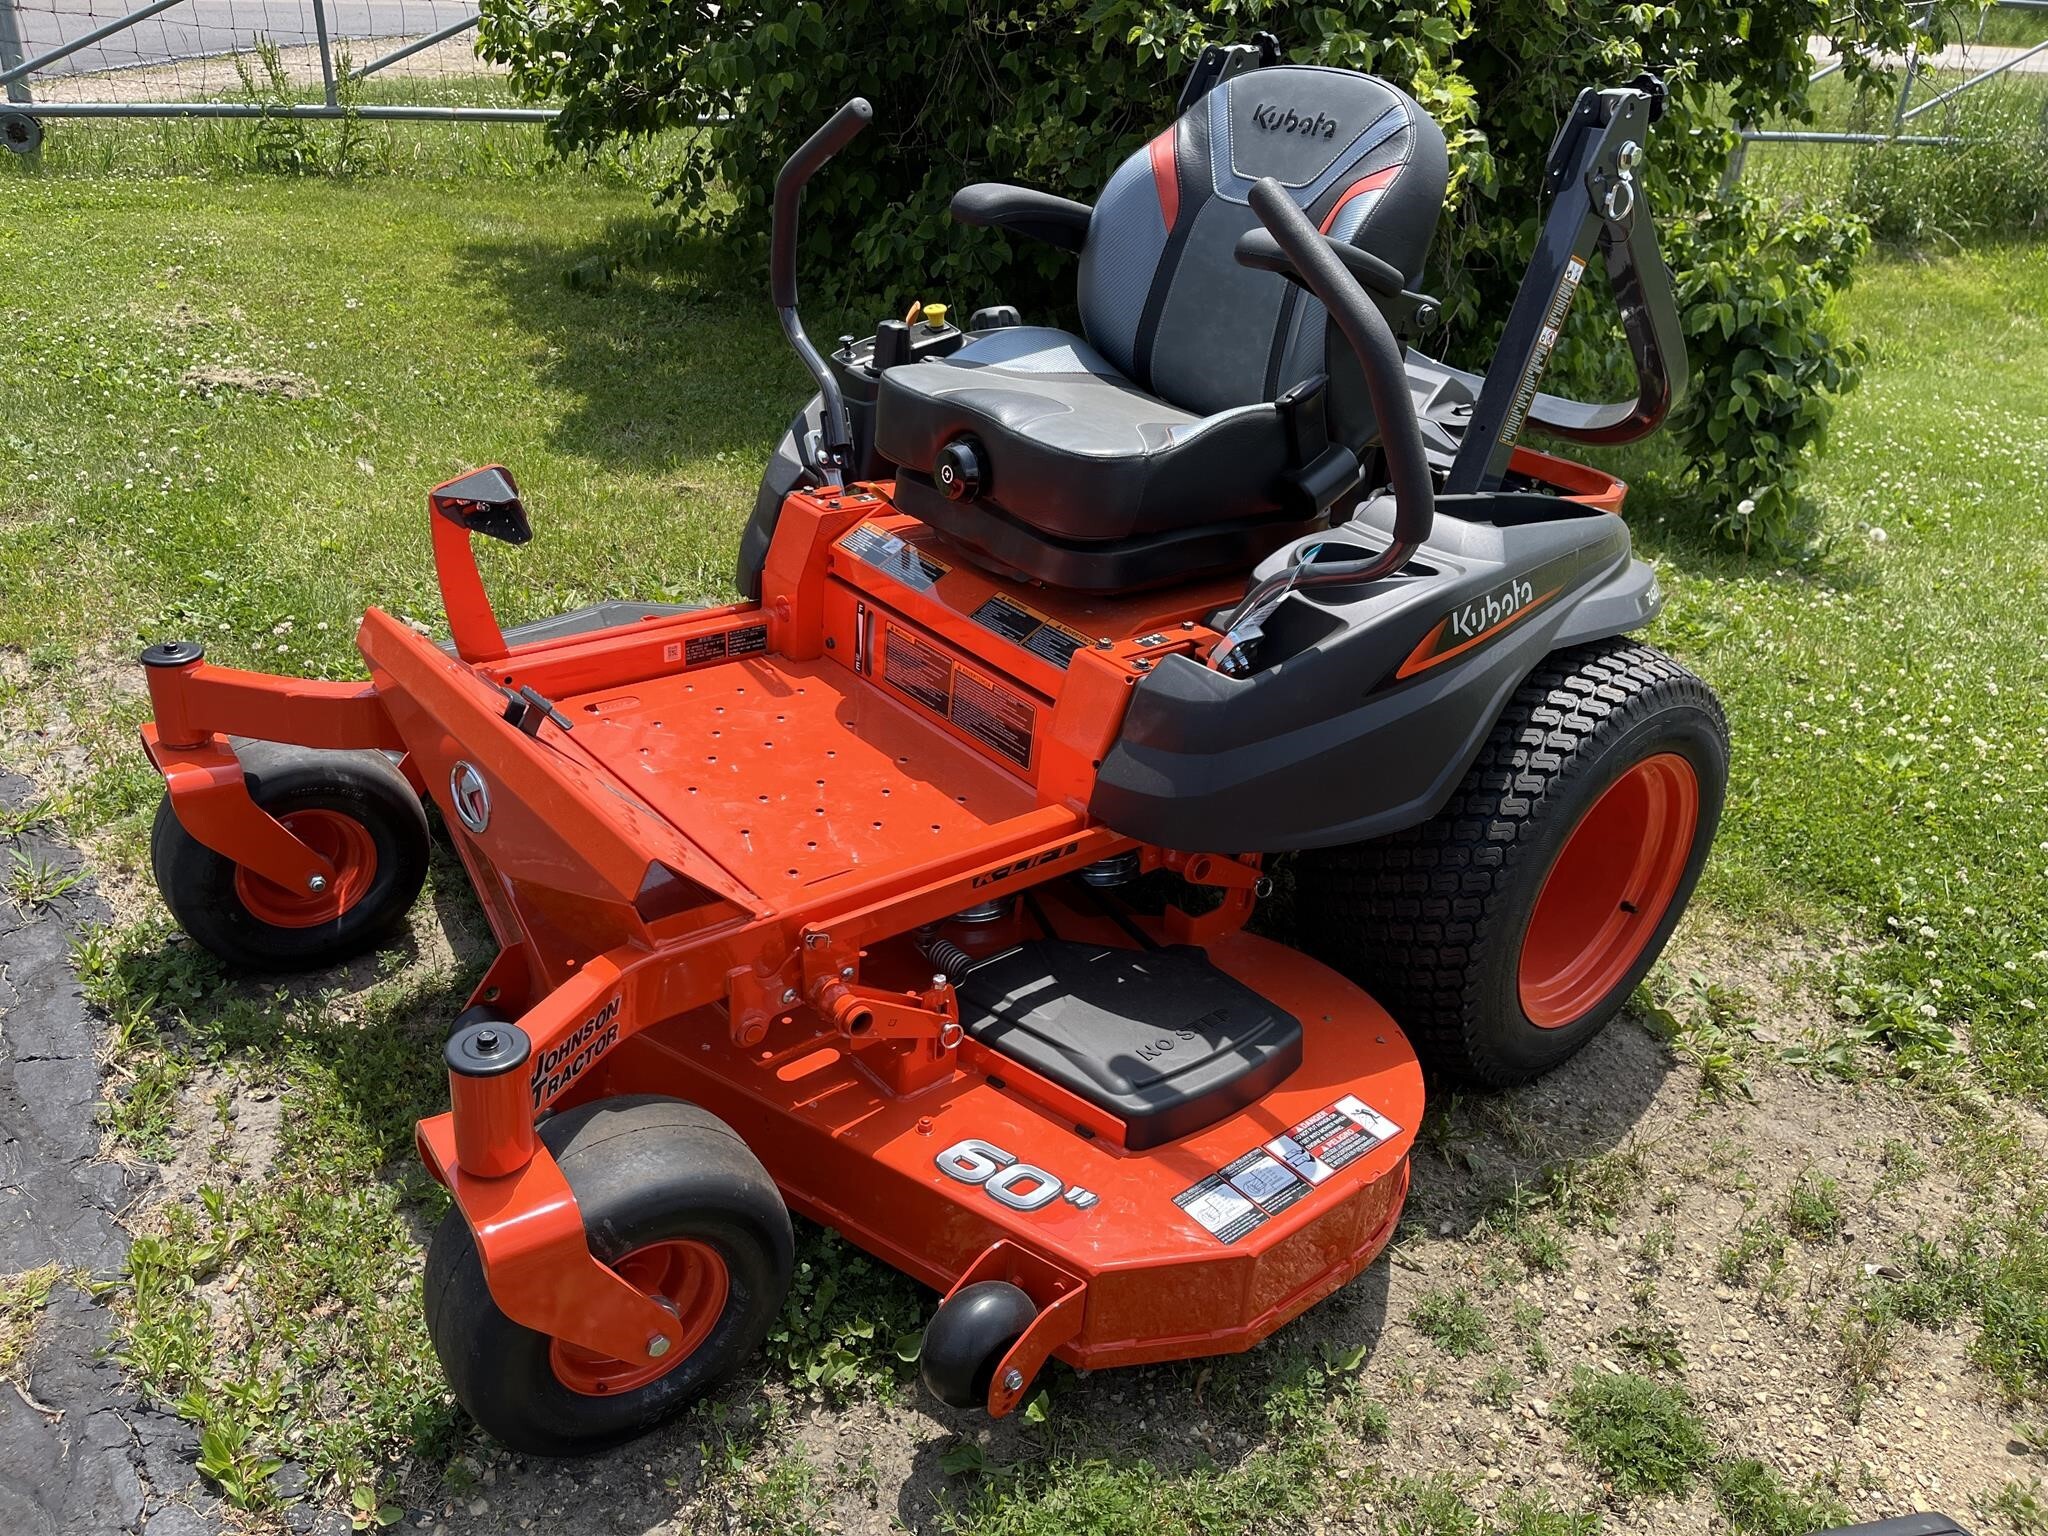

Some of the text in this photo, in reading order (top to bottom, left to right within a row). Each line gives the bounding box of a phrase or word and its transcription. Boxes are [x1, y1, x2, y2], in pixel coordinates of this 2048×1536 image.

[1253, 103, 1337, 138] Kubota
[1452, 579, 1533, 637] Kubota
[531, 995, 622, 1088] JOHNSON
[1136, 1008, 1232, 1062] NO STEP
[532, 1022, 619, 1111] TRACTOR
[1301, 1110, 1329, 1129] DANGER
[1327, 1128, 1355, 1150] PELIGRO
